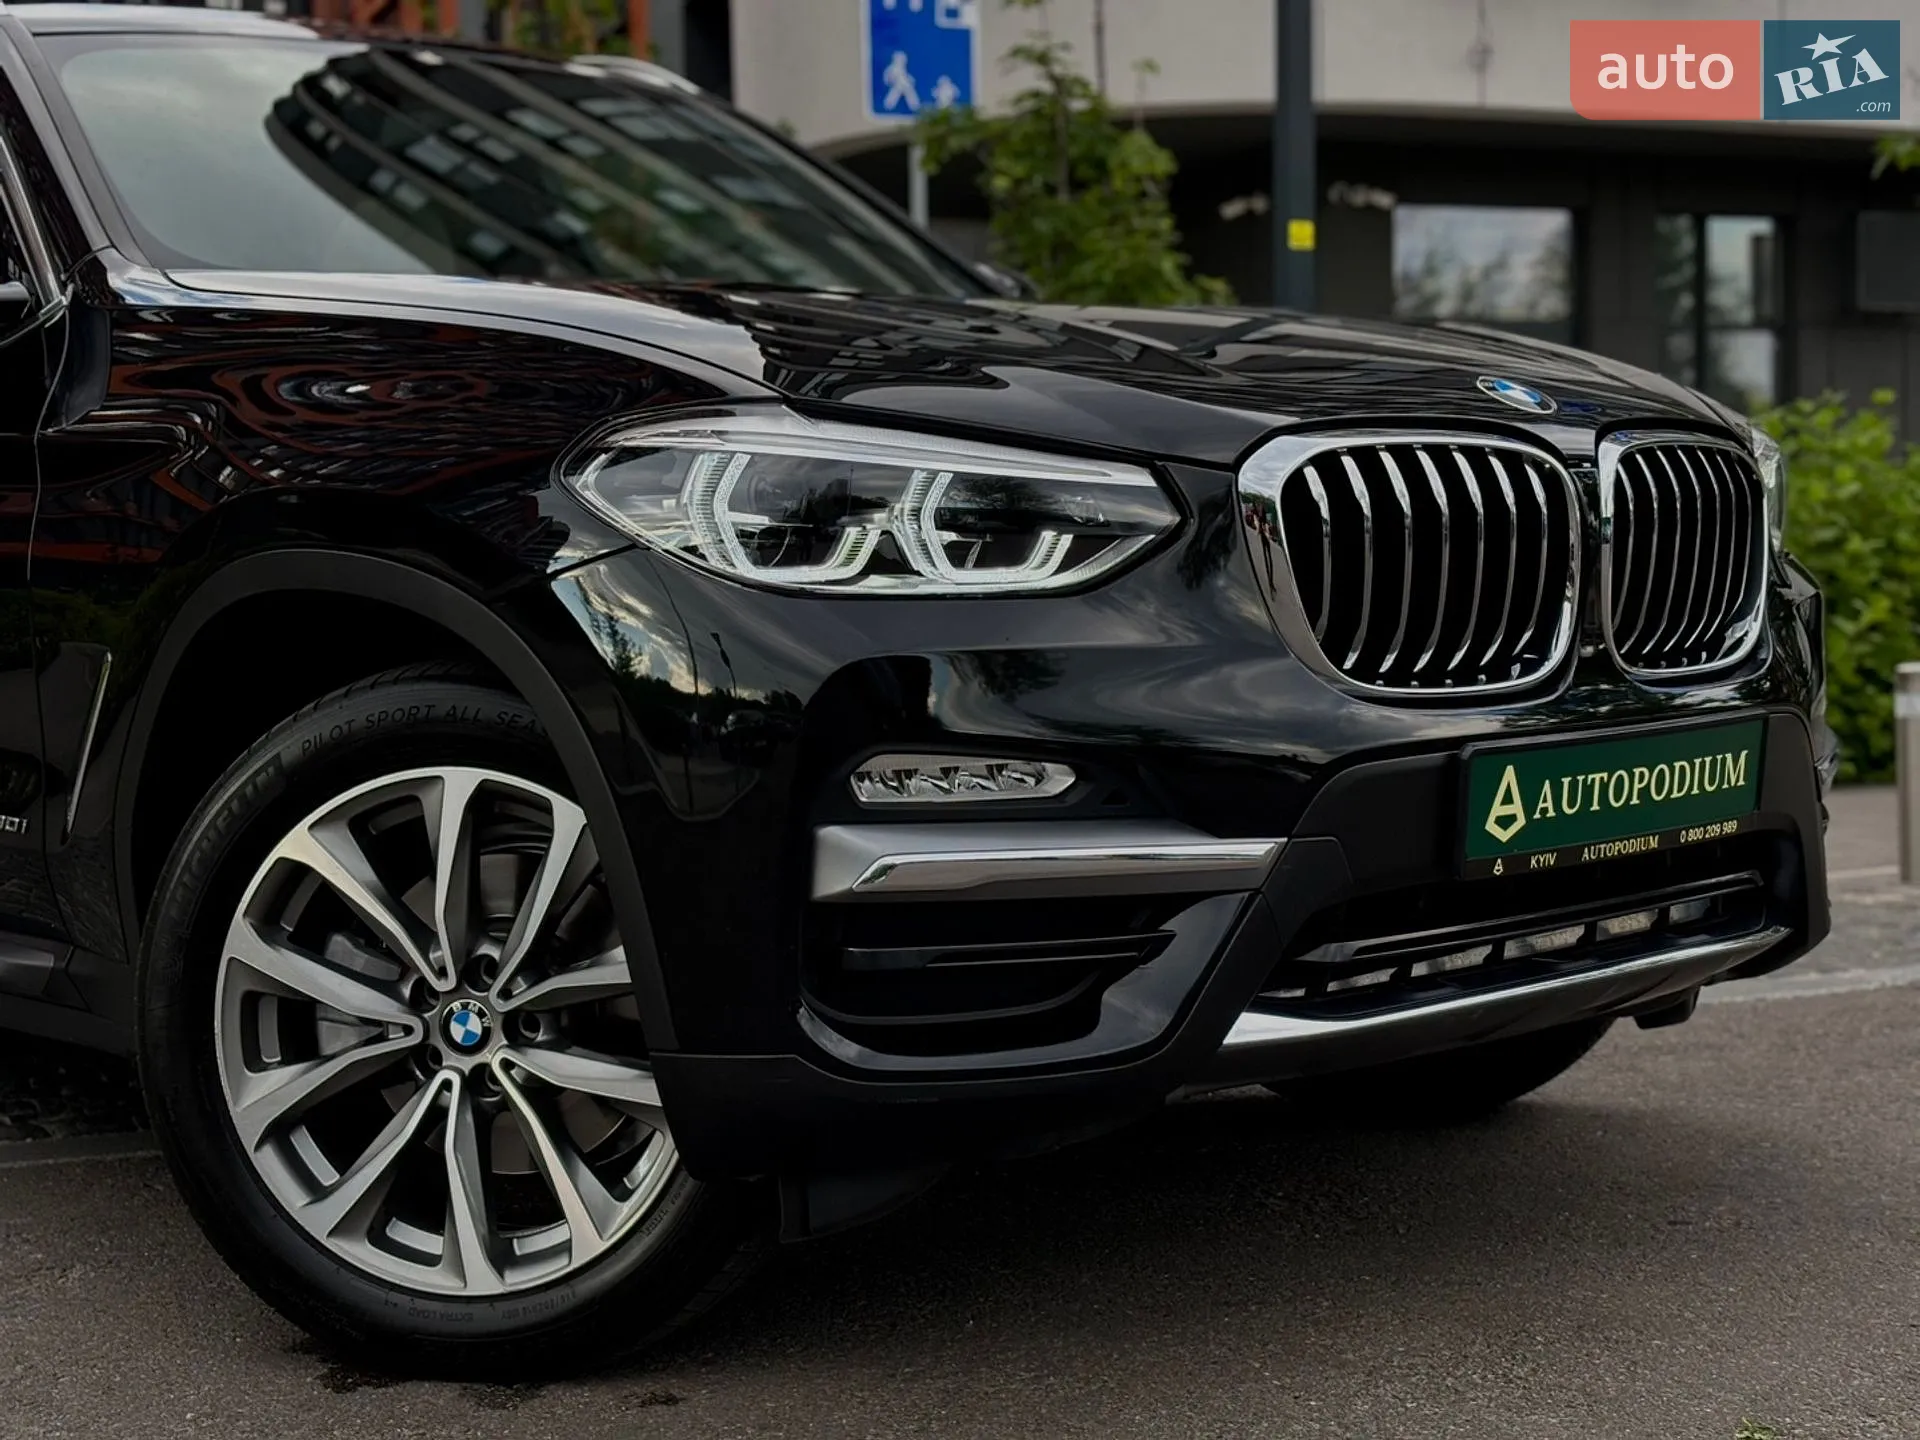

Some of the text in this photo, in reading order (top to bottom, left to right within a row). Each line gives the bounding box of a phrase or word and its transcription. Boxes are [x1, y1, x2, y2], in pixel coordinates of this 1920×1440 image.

[301, 719, 356, 757] PILOT
[366, 704, 436, 729] SPORT
[443, 704, 482, 722] ALL
[1533, 750, 1749, 819] AUTOPODIUM
[1530, 819, 1738, 869] KYIV AUTOPODIUM 0 800 209 989
